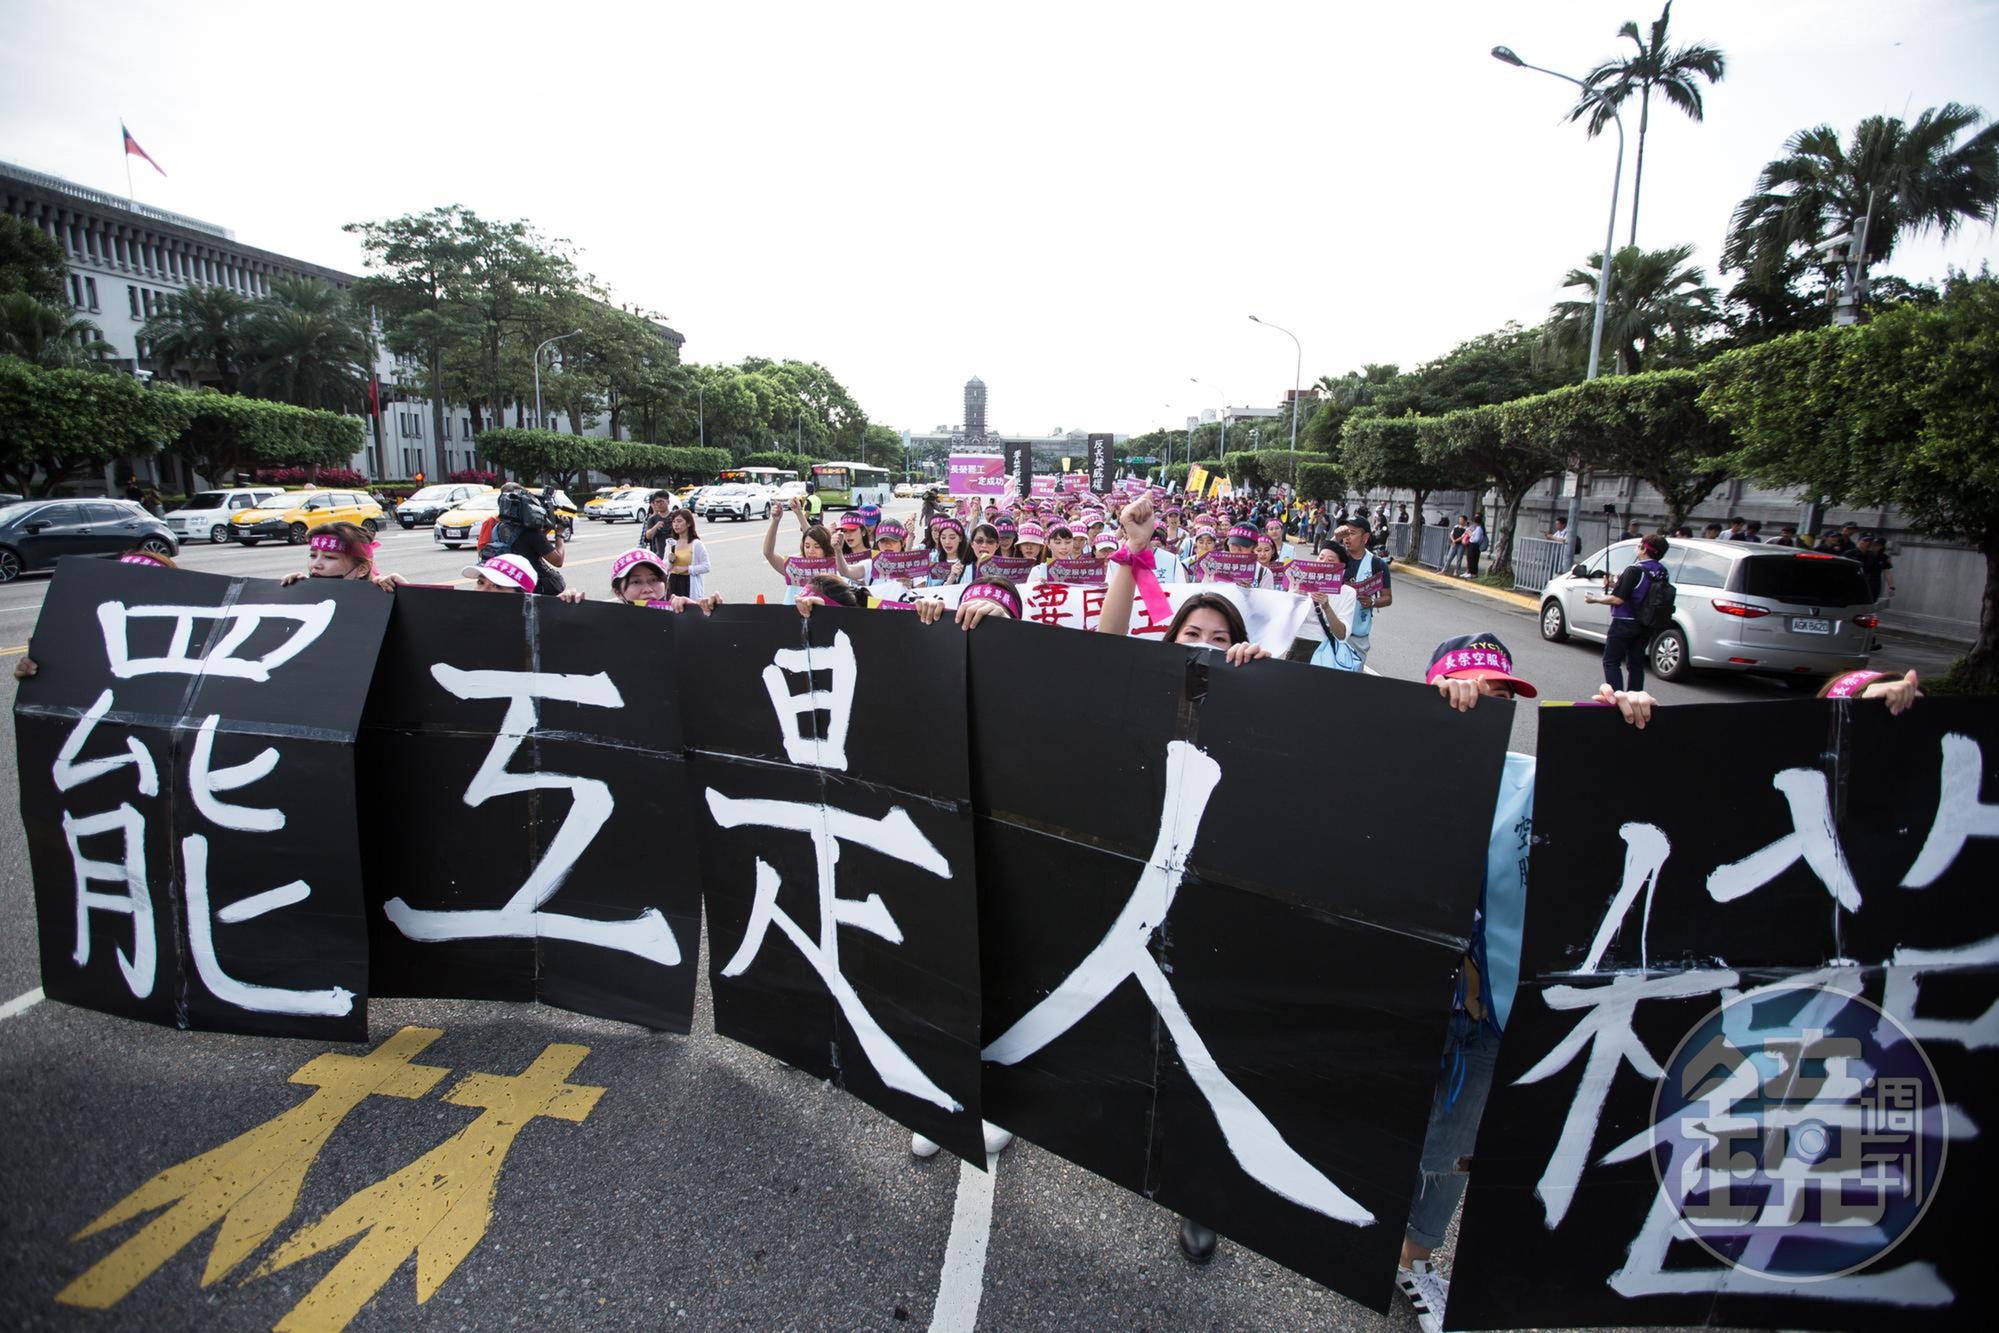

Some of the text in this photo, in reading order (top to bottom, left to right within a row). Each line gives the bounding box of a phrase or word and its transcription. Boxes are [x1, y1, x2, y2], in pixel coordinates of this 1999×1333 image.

[950, 464, 986, 474] 長榮罷工
[1093, 439, 1105, 491] 反長榮威權
[968, 476, 1005, 486] 一定成功
[980, 739, 1378, 1228] 人
